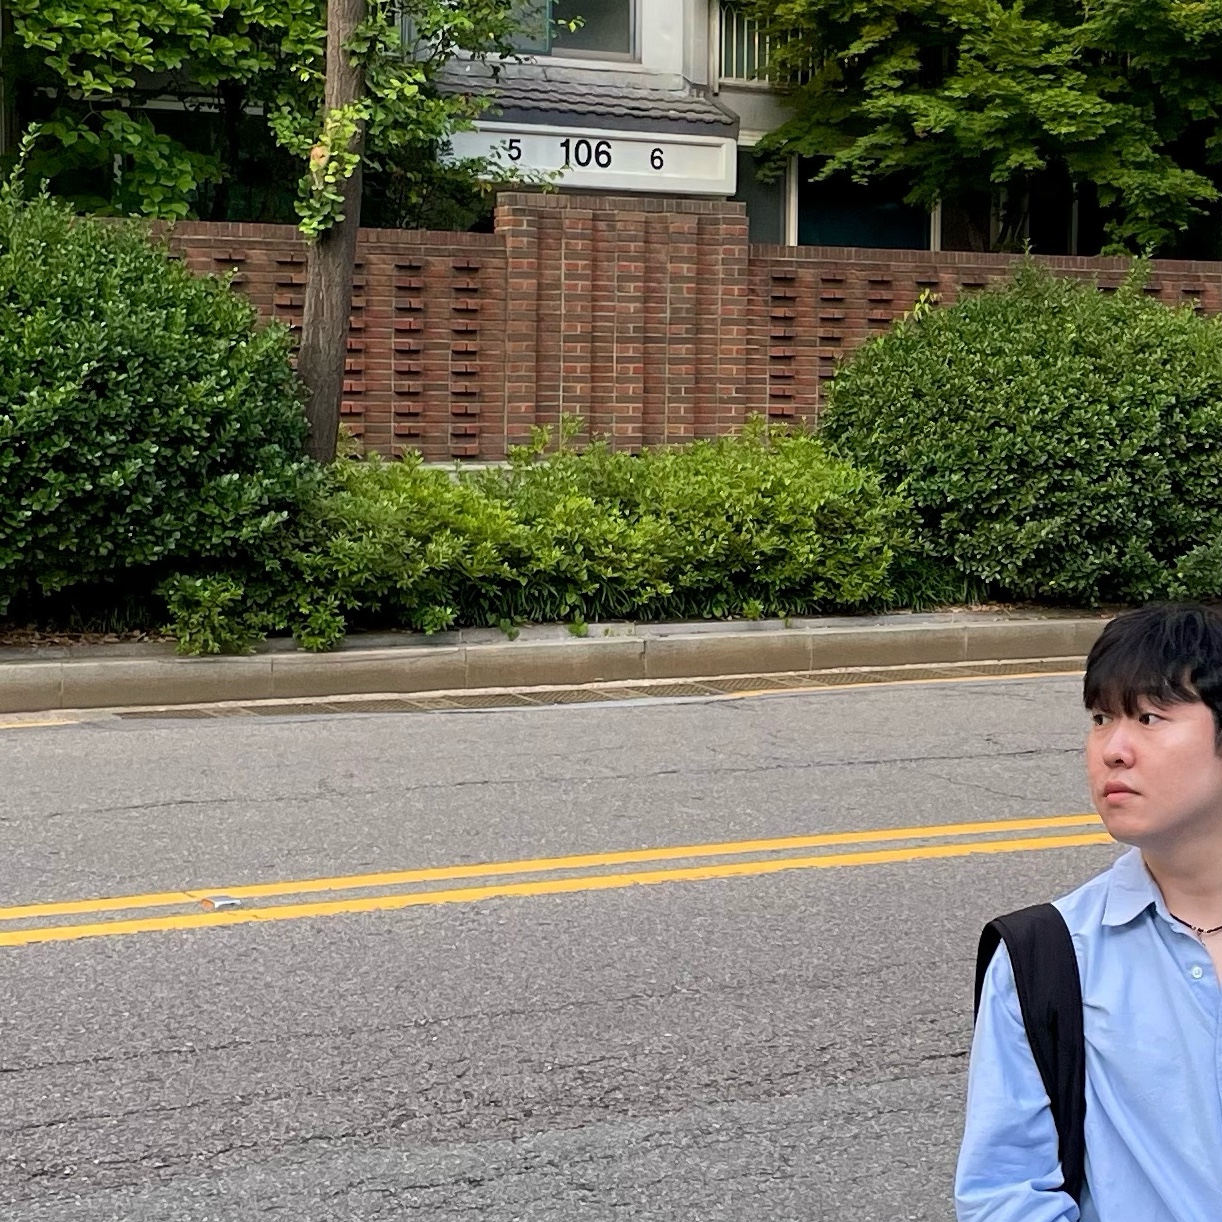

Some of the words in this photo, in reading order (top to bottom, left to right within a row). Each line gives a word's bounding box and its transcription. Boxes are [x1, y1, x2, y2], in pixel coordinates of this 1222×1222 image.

[508, 139, 521, 160] 5
[560, 138, 612, 168] 106
[650, 148, 664, 170] 6
